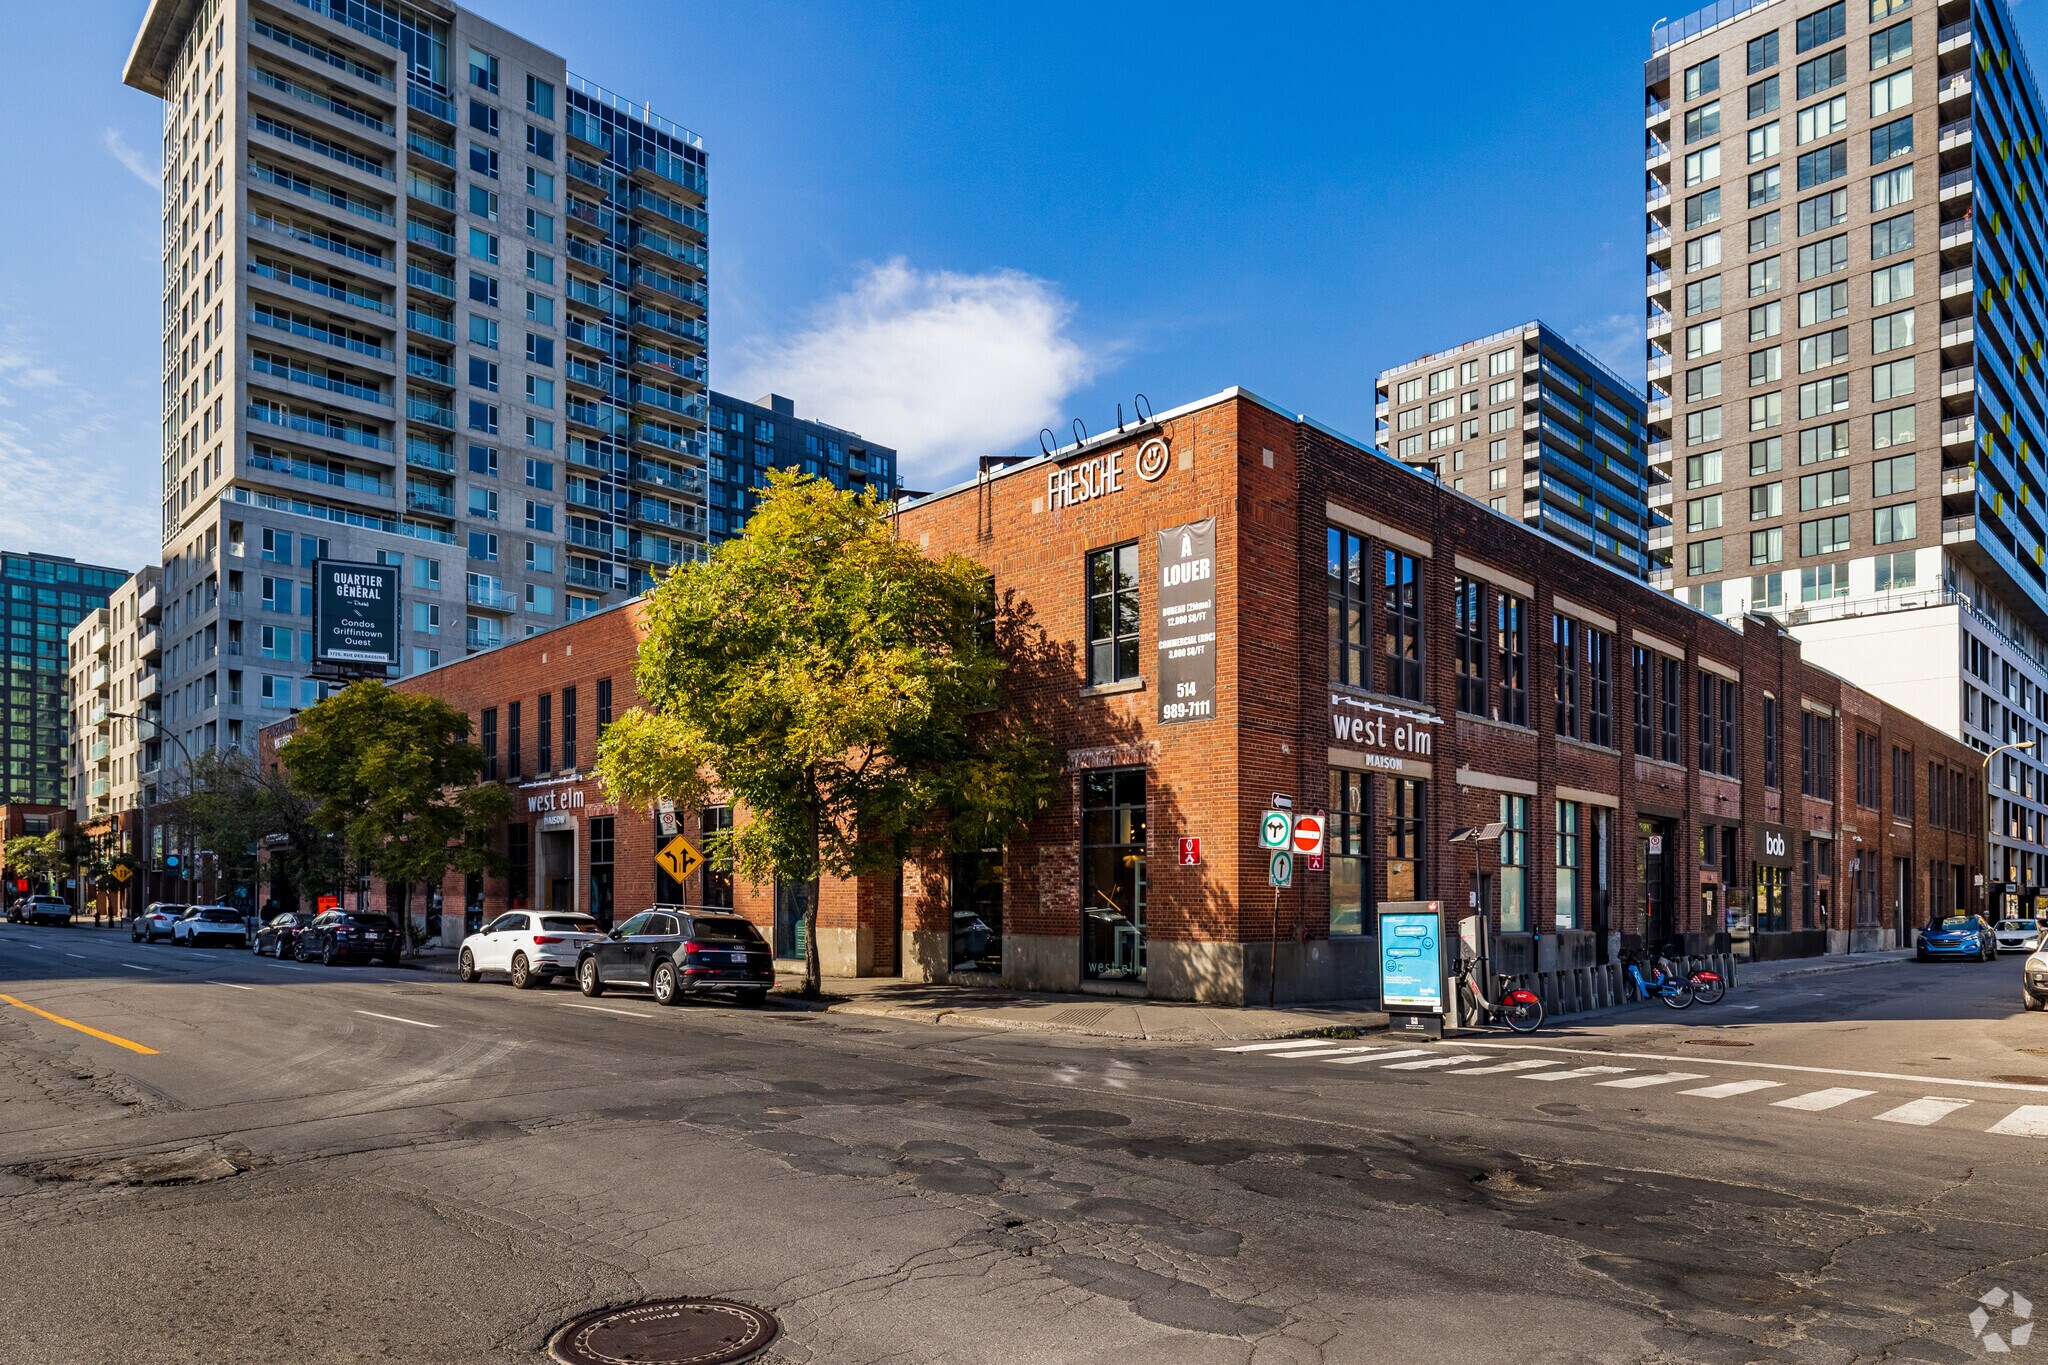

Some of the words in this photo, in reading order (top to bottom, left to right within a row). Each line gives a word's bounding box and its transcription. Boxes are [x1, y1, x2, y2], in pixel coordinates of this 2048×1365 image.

[1048, 451, 1124, 511] FRESCHE
[1181, 532, 1192, 558] À
[333, 572, 383, 588] QUARTIER
[1163, 558, 1210, 588] LOUER
[1162, 603, 1186, 617] BUREAU
[1187, 611, 1207, 623] SQ/FT
[341, 618, 375, 629] Condos
[333, 627, 383, 638] Griffintown
[344, 637, 371, 647] Ouest
[1158, 635, 1198, 650] COMMERCIAL
[1186, 644, 1206, 657] SQ/FT
[1176, 681, 1197, 698] 514
[1163, 699, 1210, 719] 989-7111
[1332, 714, 1387, 748] west
[1394, 722, 1431, 755] elm
[1365, 753, 1403, 771] MAISON
[527, 789, 557, 813] west
[560, 787, 584, 809] elm
[543, 815, 566, 825] MAISON
[1765, 831, 1785, 857] bob
